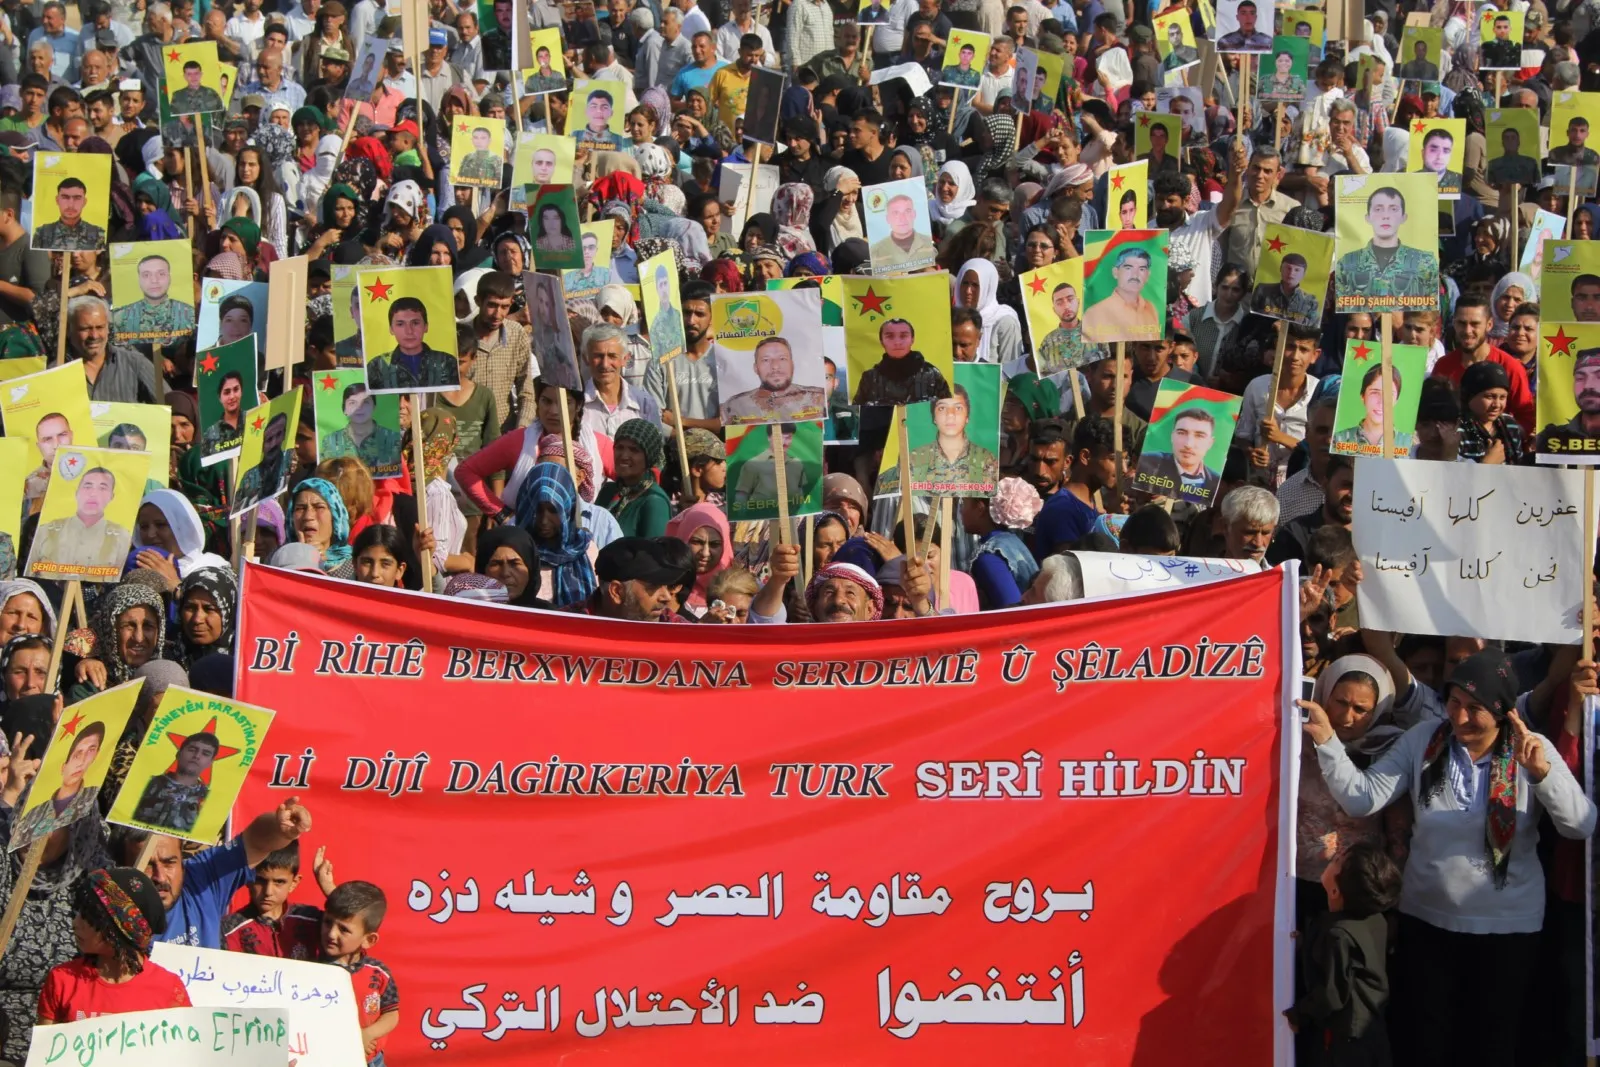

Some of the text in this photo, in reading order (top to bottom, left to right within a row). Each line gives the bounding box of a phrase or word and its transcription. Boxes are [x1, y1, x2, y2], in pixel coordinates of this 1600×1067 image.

[1397, 296, 1436, 306] SUNDUS
[934, 482, 957, 491] SARA
[250, 631, 1266, 692] Bİ RİHÊ BERXWEDANA SERDEMÊ Û ŞÊLADİZÊ
[268, 747, 315, 789] Lİ
[443, 754, 745, 797] DAGİRKERİYA
[770, 762, 894, 799] TURK
[915, 750, 1045, 799] SERÎ
[1059, 749, 1247, 798] HİLDİN
[407, 869, 480, 924] دزه
[654, 871, 784, 927] العصر
[811, 871, 953, 928] مقاومة
[420, 950, 1085, 1051] أنتفضوا ضد الأحتلال التركي
